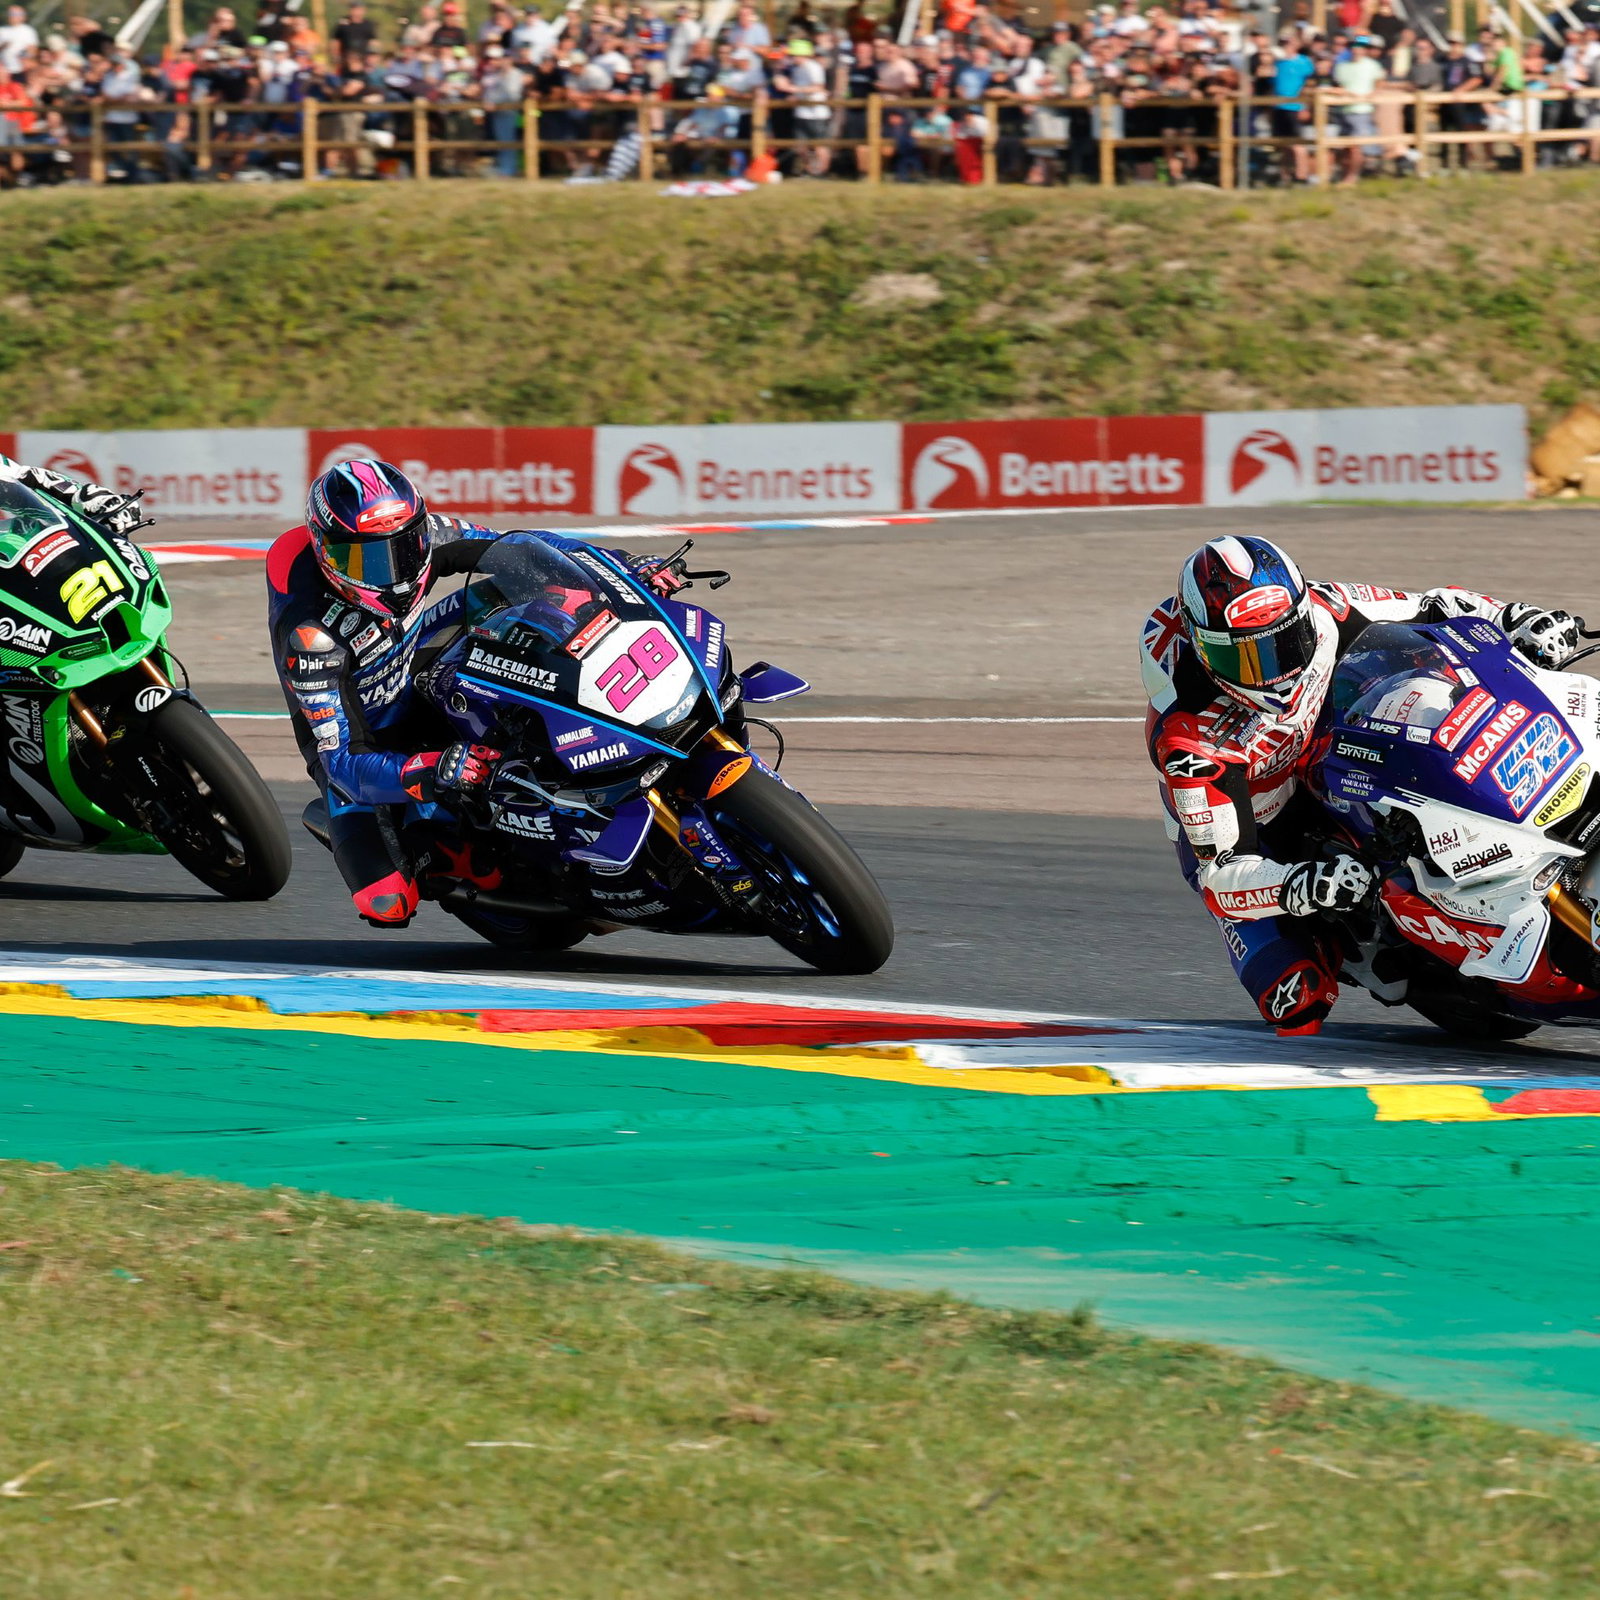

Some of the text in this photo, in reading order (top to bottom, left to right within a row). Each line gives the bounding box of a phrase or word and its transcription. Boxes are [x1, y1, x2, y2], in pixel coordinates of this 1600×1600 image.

[1002, 452, 1184, 496] Bennetts
[1315, 445, 1499, 485] Bennetts
[114, 465, 283, 506] Bennetts
[402, 460, 576, 505] Bennetts
[701, 459, 873, 500] Bennetts
[313, 484, 334, 527] BURNELL
[360, 502, 406, 523] LS2
[39, 534, 73, 556] Bennetts
[60, 560, 124, 624] 21
[1230, 590, 1286, 619] LS2
[91, 595, 126, 621] Kawasaki
[14, 623, 52, 647] AJN
[583, 613, 612, 640] Bennett
[12, 638, 47, 653] STEELSTOCK
[705, 622, 723, 669] YAMAHA
[466, 660, 557, 692] MOTORCYCLES.CO.UK
[469, 648, 559, 684] RACEWAYS
[595, 627, 678, 713] 28
[305, 706, 336, 721] Beta
[1452, 692, 1487, 726] Bennetts
[1567, 692, 1580, 716] H&J
[30, 699, 43, 742] STEELSTOCK
[555, 726, 595, 745] YAMALUBE
[1456, 703, 1526, 780] McAMS
[568, 742, 629, 770] YAMAHA
[1336, 742, 1384, 763] SYNTOL
[720, 759, 744, 780] Beta
[1346, 772, 1370, 782] ASCOTT
[1340, 778, 1374, 790] INSURANCE
[1538, 768, 1587, 823] BROSHUIS
[1557, 786, 1583, 814] HOLLAND
[695, 820, 732, 863] PIRELLI
[1429, 829, 1460, 850] H&J
[1432, 842, 1461, 856] MARTIN
[1452, 842, 1509, 873] ashvale
[732, 879, 753, 893] sbs
[1219, 888, 1281, 910] McAMS
[1467, 906, 1487, 918] OILS
[1500, 916, 1535, 965] MAR-TRAIN
